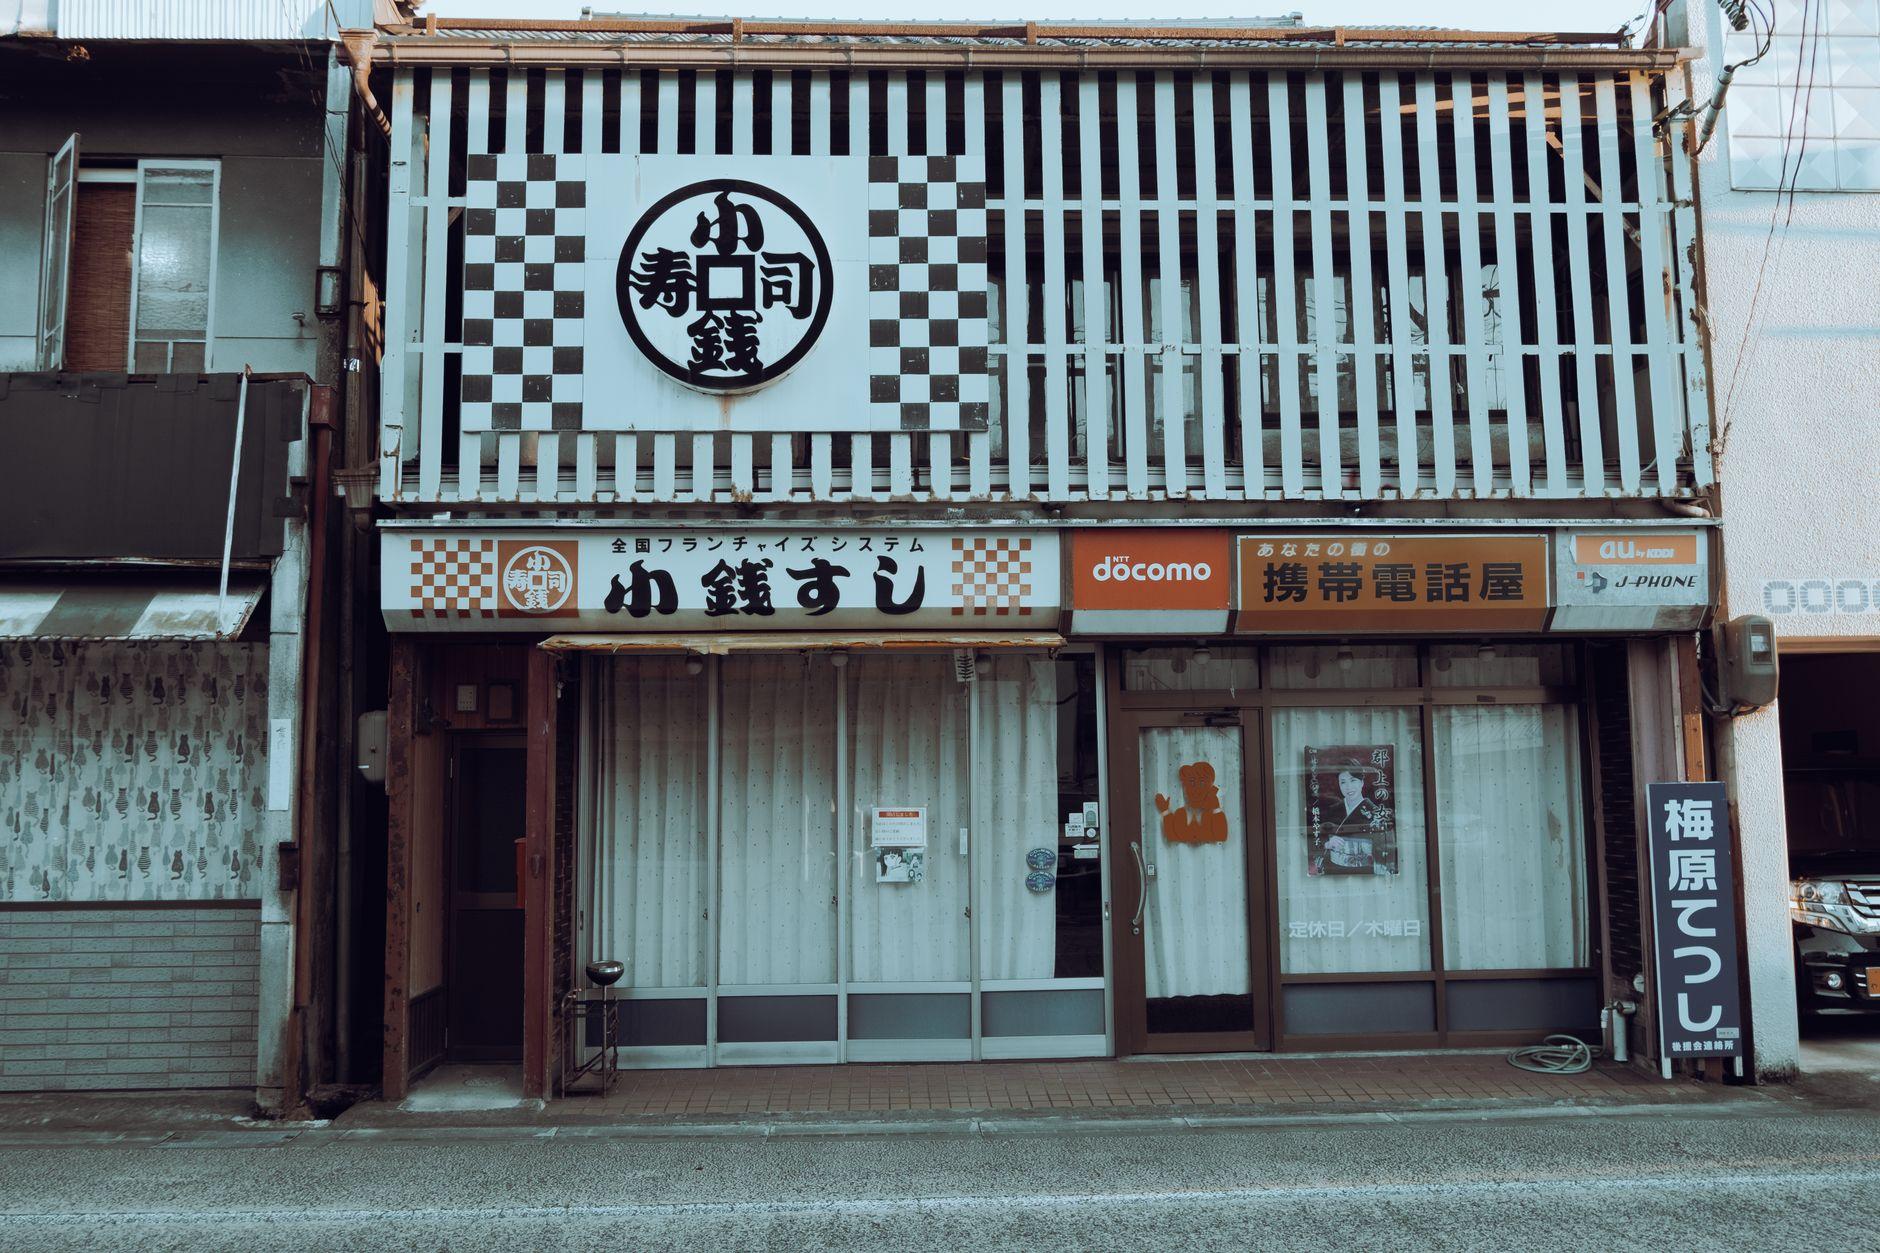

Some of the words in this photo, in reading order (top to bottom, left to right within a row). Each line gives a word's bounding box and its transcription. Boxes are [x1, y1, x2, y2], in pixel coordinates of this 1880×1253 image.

[611, 536, 925, 554] 全国フランチャイズシステム
[1257, 542, 1391, 557] あなたの街の
[1599, 541, 1635, 559] au
[1113, 555, 1130, 563] NTT
[1092, 556, 1212, 582] docomo
[603, 555, 926, 619] 小銭すし
[1263, 561, 1525, 604] 携帯電話屋
[1615, 576, 1698, 588] J-PHONE
[1664, 798, 1723, 1033] 梅原てつし
